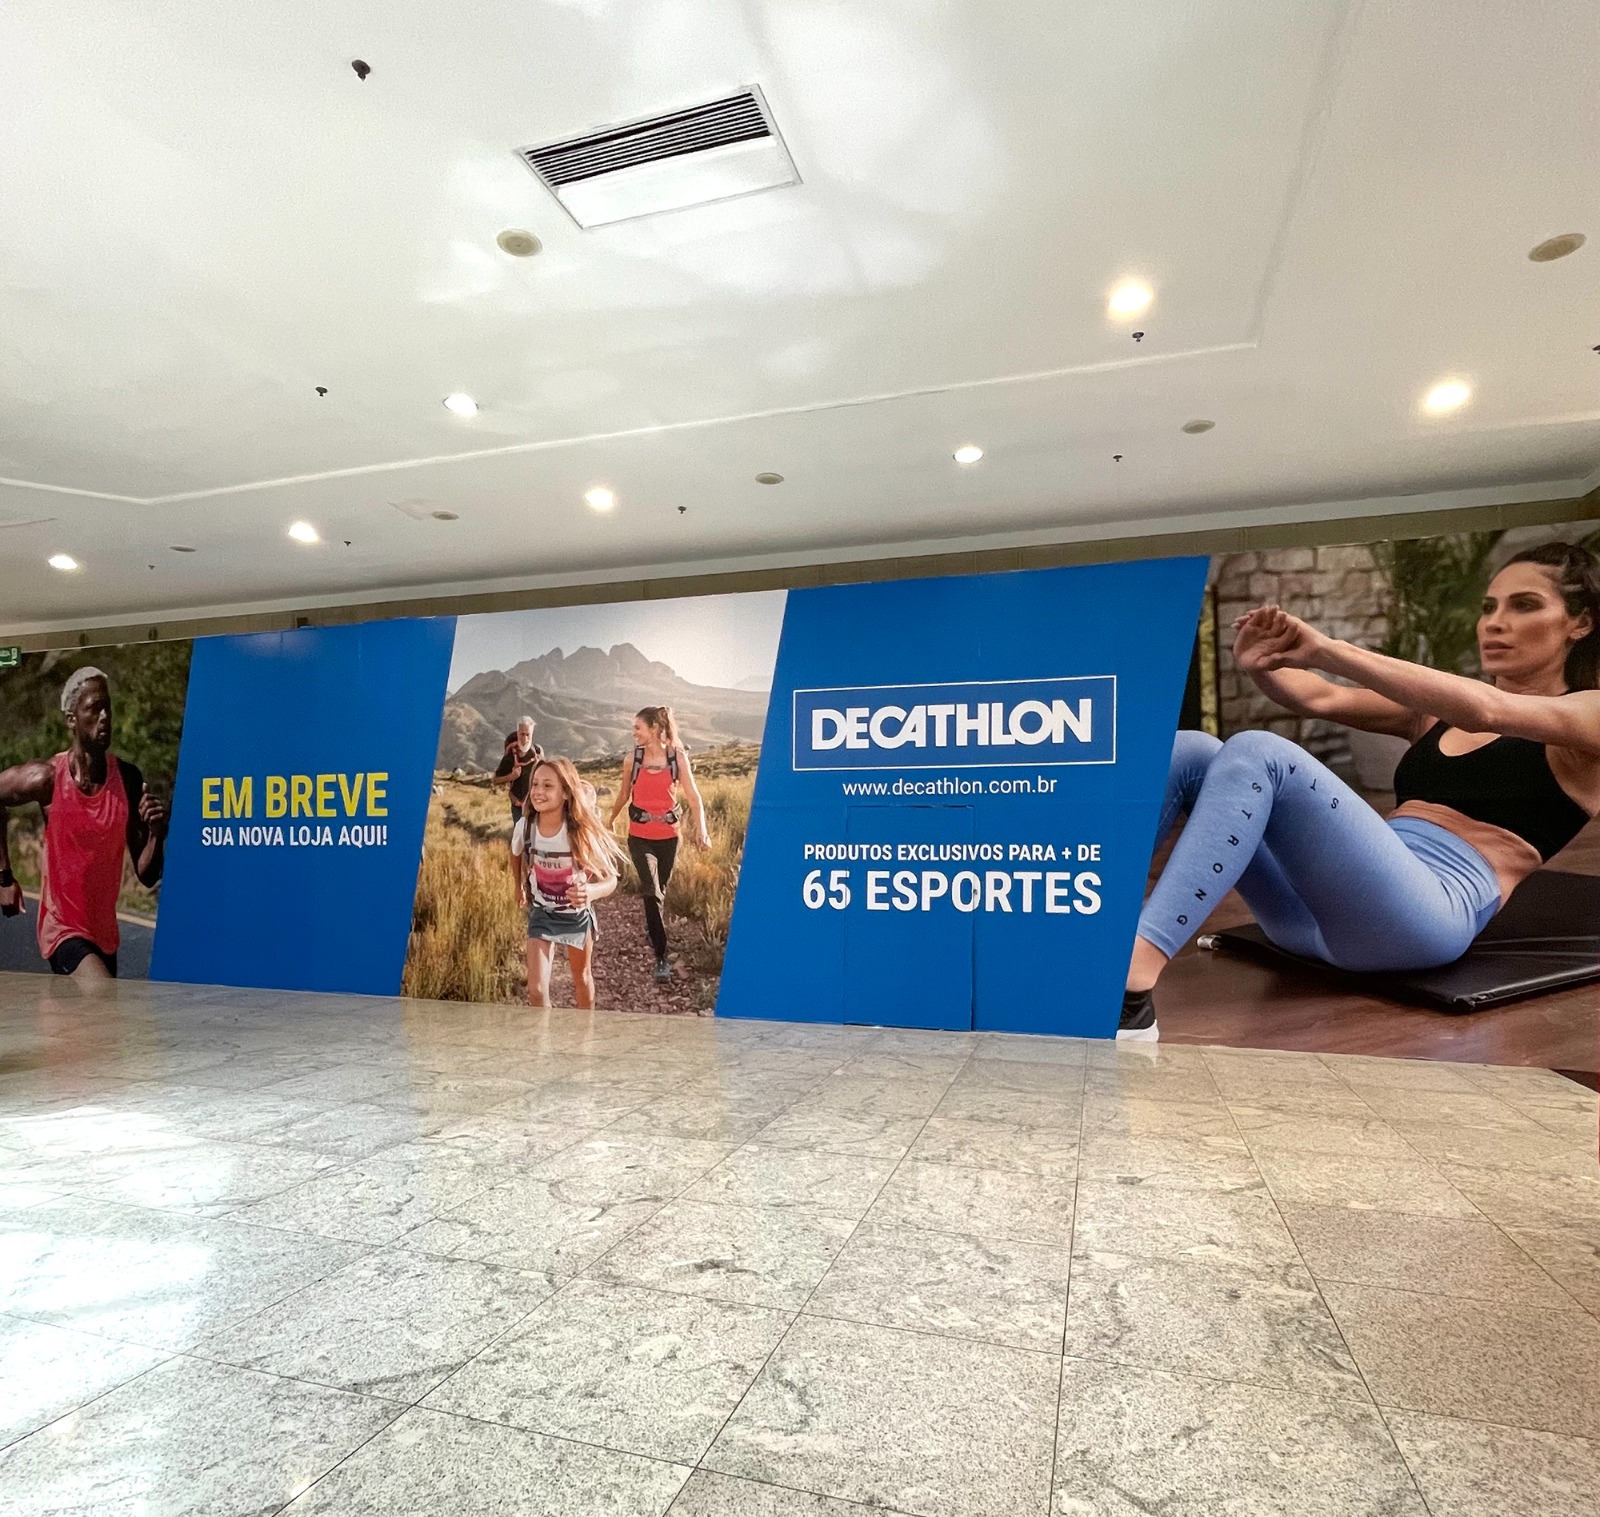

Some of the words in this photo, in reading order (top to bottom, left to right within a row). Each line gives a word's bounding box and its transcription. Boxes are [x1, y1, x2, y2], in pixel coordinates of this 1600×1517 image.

[811, 698, 1092, 751] DECATHLON
[202, 776, 253, 819] EM
[265, 772, 389, 818] BREVE
[842, 775, 1058, 796] www.decathlon.com.br
[201, 826, 234, 846] SUA
[239, 826, 285, 846] NOVA
[289, 825, 334, 846] LOJA
[338, 825, 387, 849] AQUI!
[803, 843, 893, 861] PRODUTOS
[897, 843, 1004, 862] EXCLUSIVOS
[1008, 844, 1057, 862] PARA
[1061, 847, 1072, 860] +
[1077, 844, 1101, 862] DE
[1176, 782, 1262, 926] STRONG
[802, 869, 852, 911] 65
[866, 870, 1102, 915] ESPORTES
